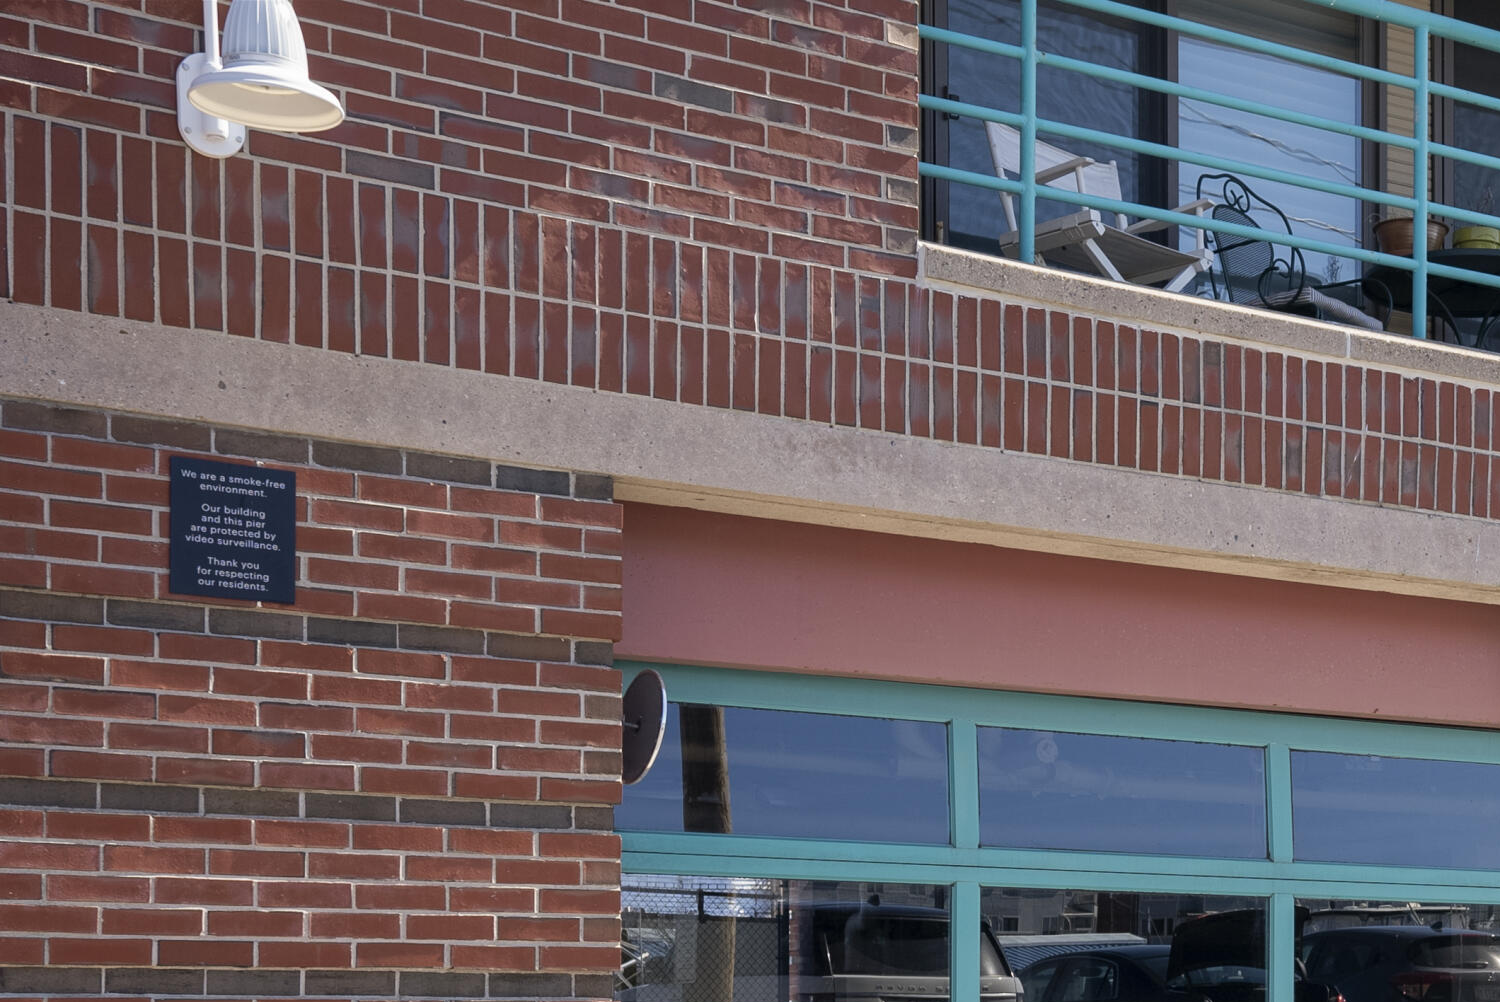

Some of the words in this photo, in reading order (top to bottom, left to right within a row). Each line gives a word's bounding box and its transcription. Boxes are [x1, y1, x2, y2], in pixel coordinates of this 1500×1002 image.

[181, 469, 197, 479] We
[200, 473, 216, 481] are
[229, 476, 285, 489] smoke-free
[200, 483, 267, 497] environment.
[201, 504, 220, 512] Our
[224, 506, 265, 520] building
[201, 515, 220, 523] and
[224, 517, 242, 526] this
[246, 520, 265, 528] pier
[191, 524, 207, 532] are
[210, 526, 260, 539] protected
[264, 531, 276, 541] by
[185, 534, 214, 544] video
[217, 538, 280, 551] surveillance.
[208, 557, 238, 567] Thank
[241, 561, 259, 570] you
[197, 566, 211, 575] for
[215, 569, 269, 582] respecting
[198, 578, 215, 586] our
[218, 580, 268, 591] residents.
